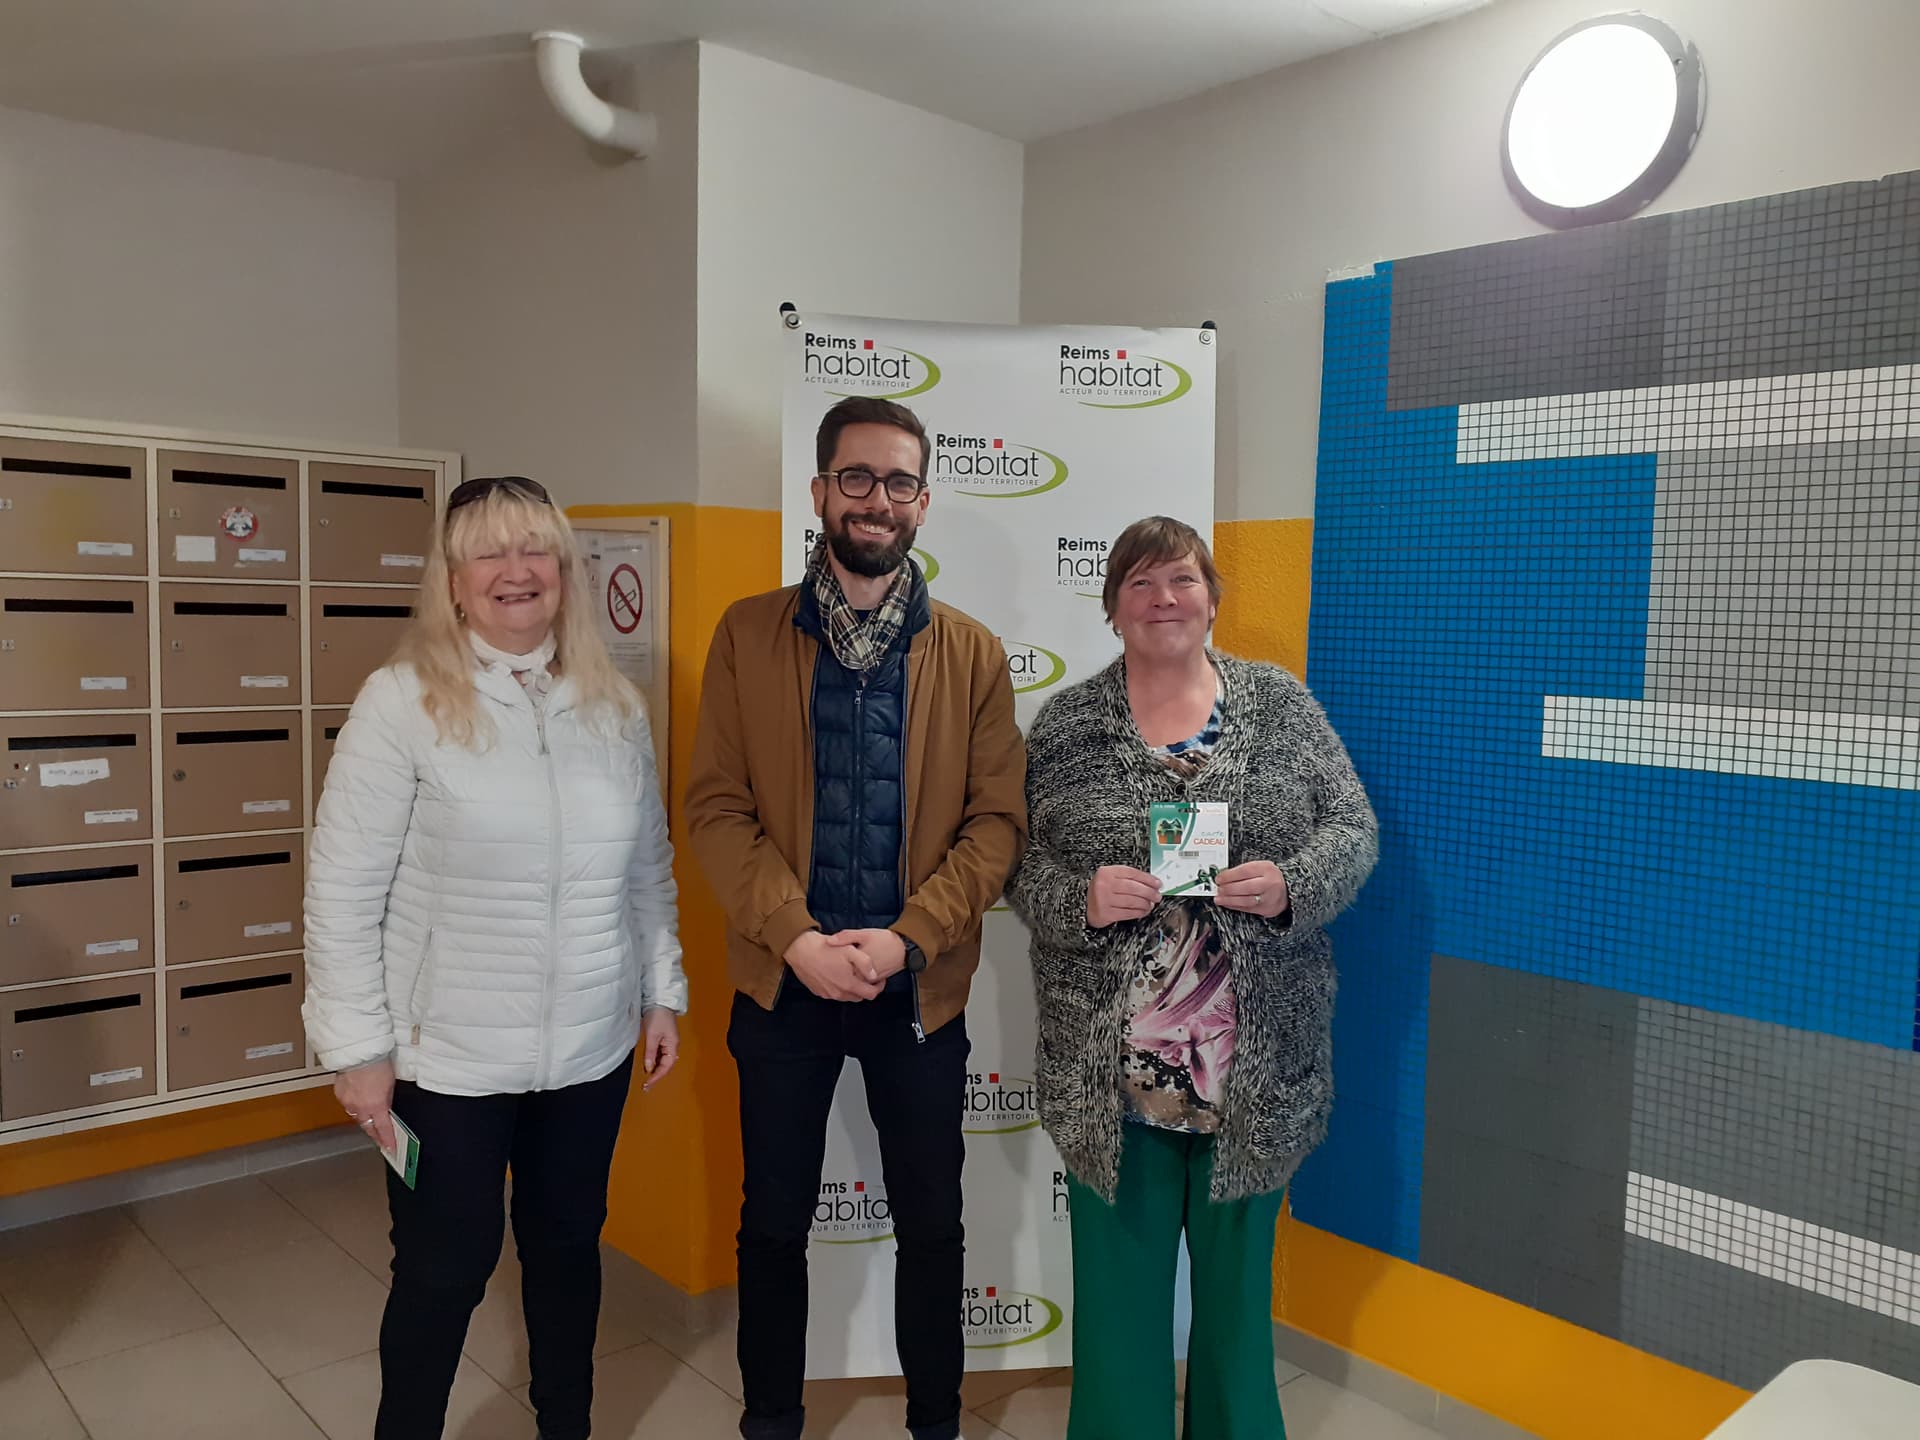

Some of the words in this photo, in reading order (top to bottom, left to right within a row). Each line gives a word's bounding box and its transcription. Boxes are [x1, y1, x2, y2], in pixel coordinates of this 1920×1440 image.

[805, 333, 857, 350] Reims
[1060, 345, 1111, 360] Reims
[805, 349, 911, 379] habitat
[1060, 360, 1164, 388] habitat
[804, 376, 839, 384] ACTEUR
[843, 378, 856, 386] DU
[861, 379, 911, 388] TERRITOIRE
[1097, 388, 1109, 396] DU
[1114, 389, 1163, 397] TERRITOIRE
[936, 433, 987, 449] Reims
[936, 449, 1039, 477] habitat
[990, 478, 1039, 486] TERRITOIRE
[1057, 537, 1108, 551] Reims
[1193, 838, 1226, 846] CADEAU
[986, 1113, 1035, 1121] TERRITOIRE
[814, 1194, 890, 1222] abita
[812, 1224, 829, 1232] EUR
[833, 1224, 846, 1232] DU
[984, 1326, 1033, 1335] TERRITOIRE
